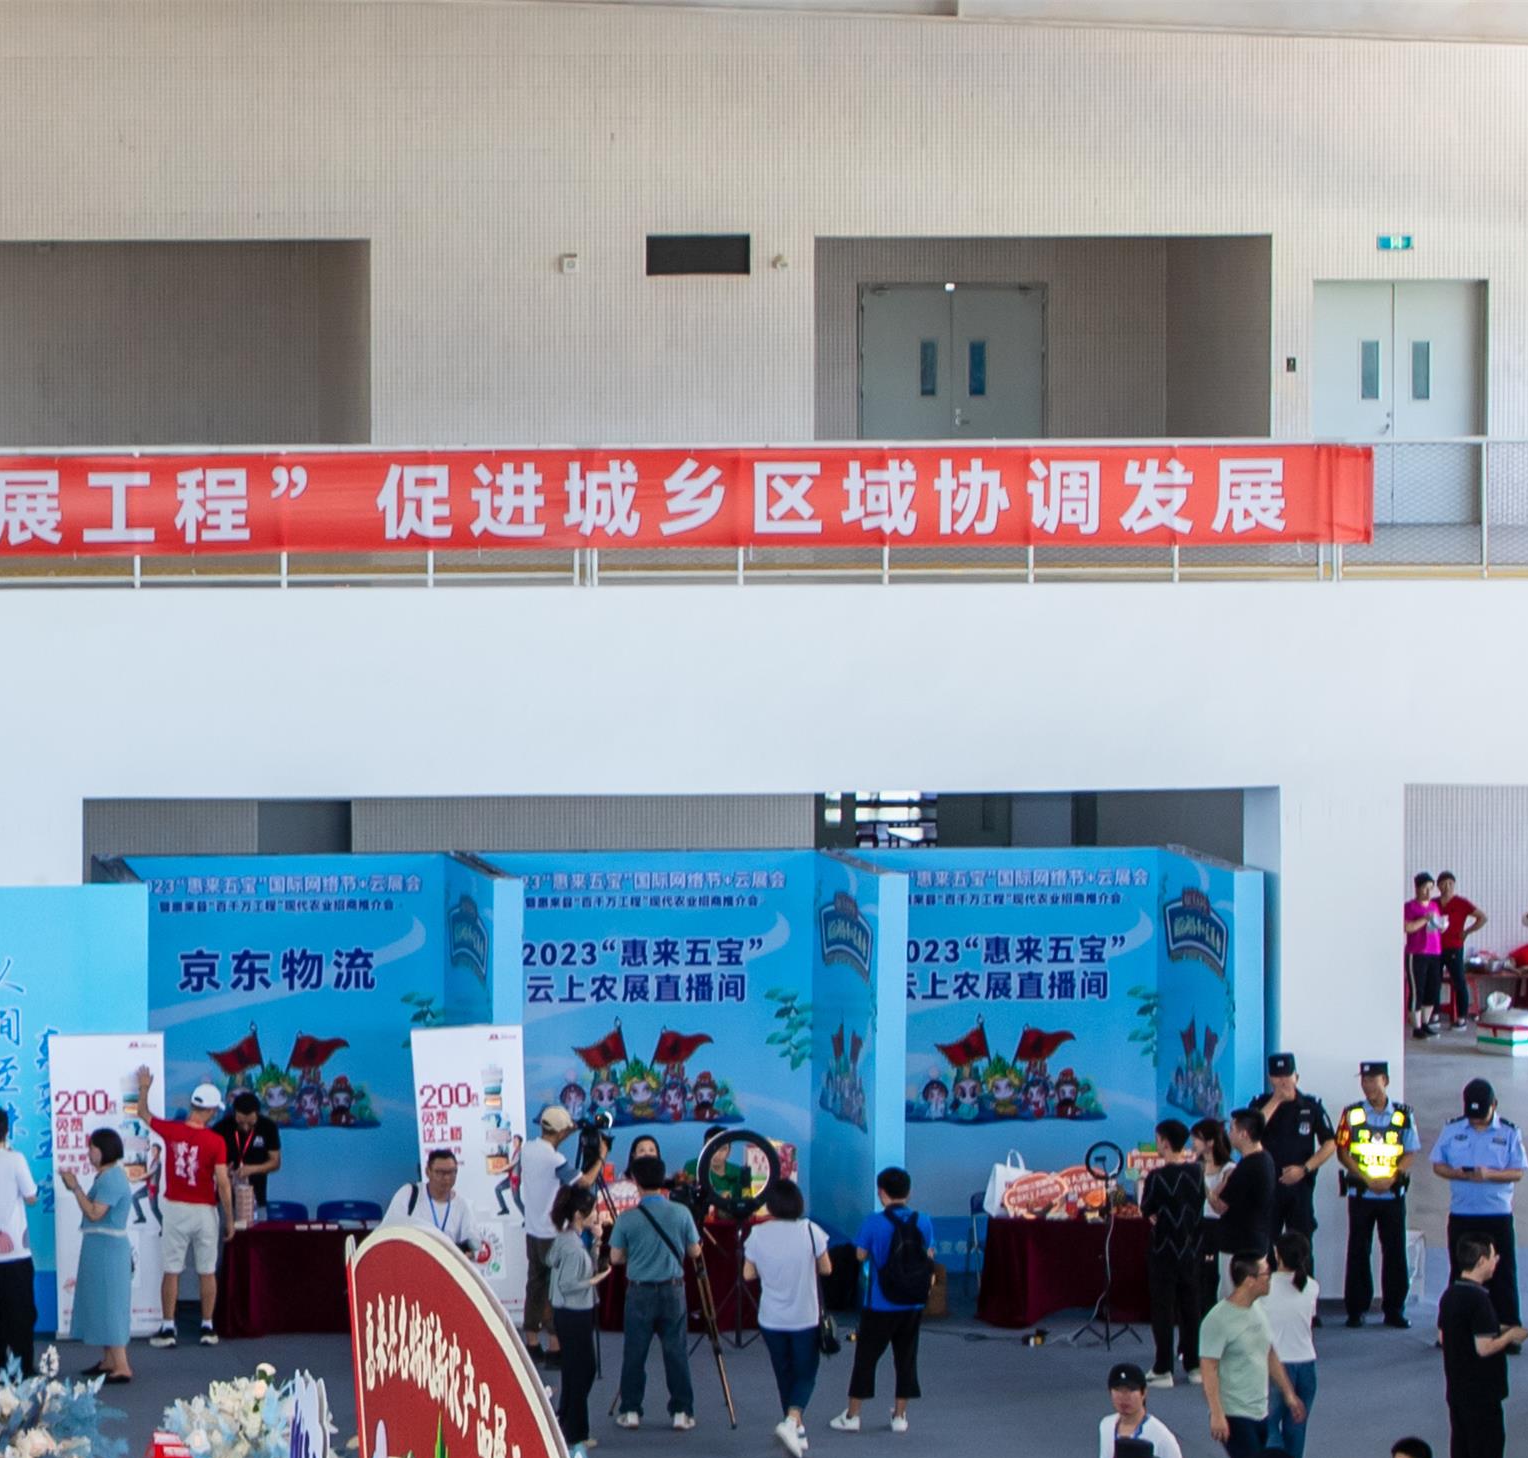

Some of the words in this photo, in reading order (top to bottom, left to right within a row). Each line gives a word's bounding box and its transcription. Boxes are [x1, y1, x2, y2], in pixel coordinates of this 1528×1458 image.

[376, 456, 1287, 541] 促进城乡区域协调发展
[179, 948, 376, 993] 京东物流
[526, 973, 747, 1004] 云上农展直播间
